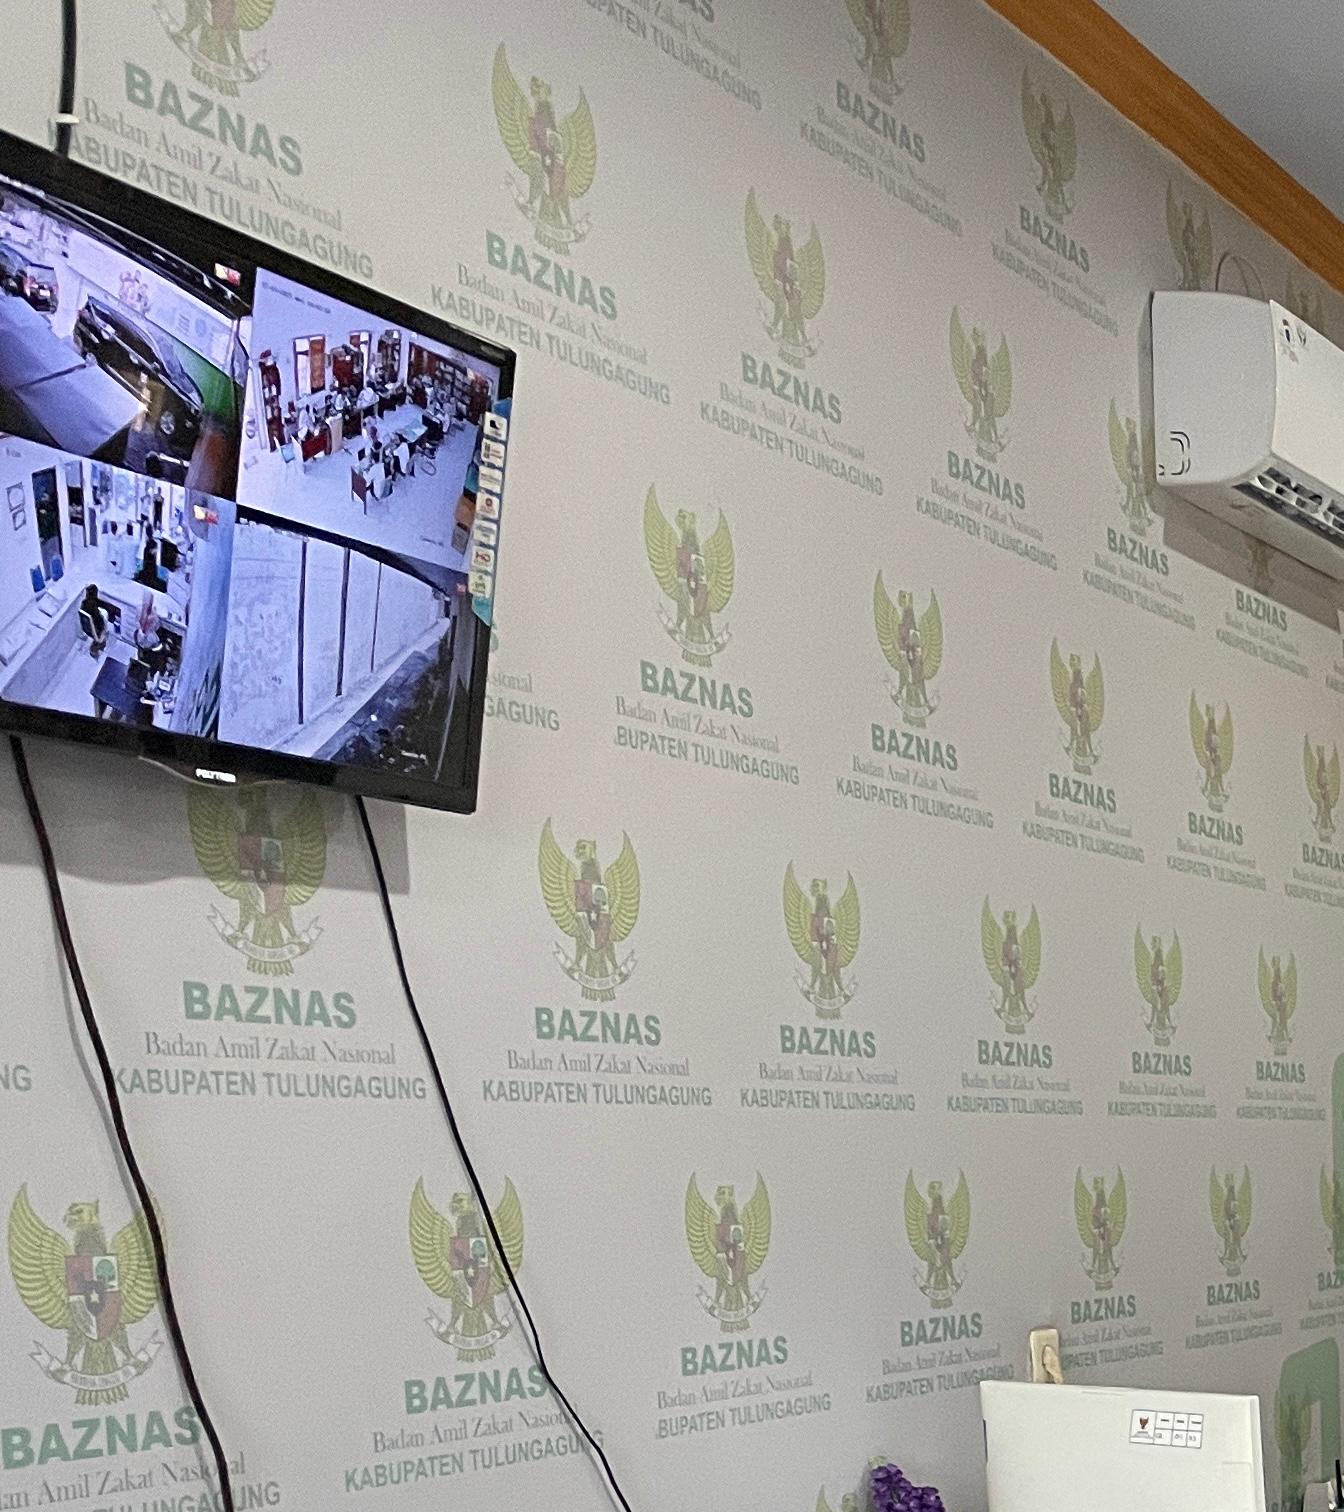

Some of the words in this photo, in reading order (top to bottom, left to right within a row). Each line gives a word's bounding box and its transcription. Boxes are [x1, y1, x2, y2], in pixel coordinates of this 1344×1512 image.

[121, 58, 303, 180] BAZNAS
[835, 77, 926, 166] BAZNAS
[83, 95, 148, 148] Badan
[155, 127, 203, 172] Amil
[206, 150, 260, 197] Zakat
[266, 177, 342, 233] Nasional
[204, 184, 374, 280] TULUNGAGUNG
[1019, 203, 1090, 276] BAZNAS
[484, 228, 618, 324] BAZNAS
[457, 260, 504, 303] Badan
[509, 284, 544, 321] Amil
[546, 301, 586, 340] Zakat
[590, 321, 647, 367] Nasional
[430, 281, 541, 352] KABUPATEN
[545, 331, 671, 407] TULUNGAGUNG
[740, 349, 842, 427] BAZNAS
[946, 448, 1025, 512] BAZNAS
[1106, 525, 1169, 579] BAZNAS
[639, 658, 754, 720] BAZNAS
[615, 694, 656, 724] Badan
[660, 705, 690, 732] Amil
[692, 713, 726, 741] Zakat
[730, 723, 779, 754] Nasional
[870, 722, 958, 773] BAZNAS
[613, 723, 688, 761] BUPATEN
[691, 741, 800, 786] TULUNGAGUNG
[835, 775, 908, 810] KABUPATEN
[910, 792, 994, 830] TULUNGAGUNG
[1048, 771, 1116, 814] BAZNAS
[1187, 810, 1243, 847] BAZNAS
[181, 980, 358, 1030] BAZNAS
[533, 1005, 662, 1047] BAZNAS
[143, 1030, 207, 1057] Badan
[214, 1033, 261, 1060] Amil
[264, 1036, 316, 1062] Zakat
[322, 1039, 397, 1066] Nasional
[507, 1048, 553, 1071] Badan
[557, 1050, 591, 1073] Amil
[593, 1052, 631, 1075] Zakat
[635, 1054, 690, 1077] Nasional
[779, 1023, 876, 1059] BAZNAS
[977, 1038, 1053, 1069] BAZNAS
[1131, 1050, 1192, 1077] BAZNAS
[262, 1071, 428, 1100] TULUNGAGUNG
[481, 1078, 588, 1104] KABUPATEN
[591, 1082, 713, 1106] TULUNGAGUNG
[739, 1087, 820, 1109] KABUPATEN
[822, 1090, 915, 1111] TULUNGAGUNG
[1070, 1294, 1136, 1324] BAZNAS
[1206, 1279, 1260, 1306] BAZNAS
[899, 1311, 982, 1348] BAZNAS
[679, 1335, 788, 1377] BAZNAS
[402, 1364, 548, 1415] BAZNAS
[0, 1405, 203, 1470] BAZNAS
[372, 1424, 424, 1453] Badan
[429, 1418, 468, 1445] Amil
[470, 1412, 513, 1439] Zakat
[654, 1409, 725, 1440] BUPATEN
[728, 1392, 832, 1427] TULUNGAGUNG
[35, 1472, 90, 1505] Amil
[93, 1463, 154, 1496] Zakat
[161, 1450, 247, 1486] Nasial
[342, 1451, 464, 1492] KABUPATEN
